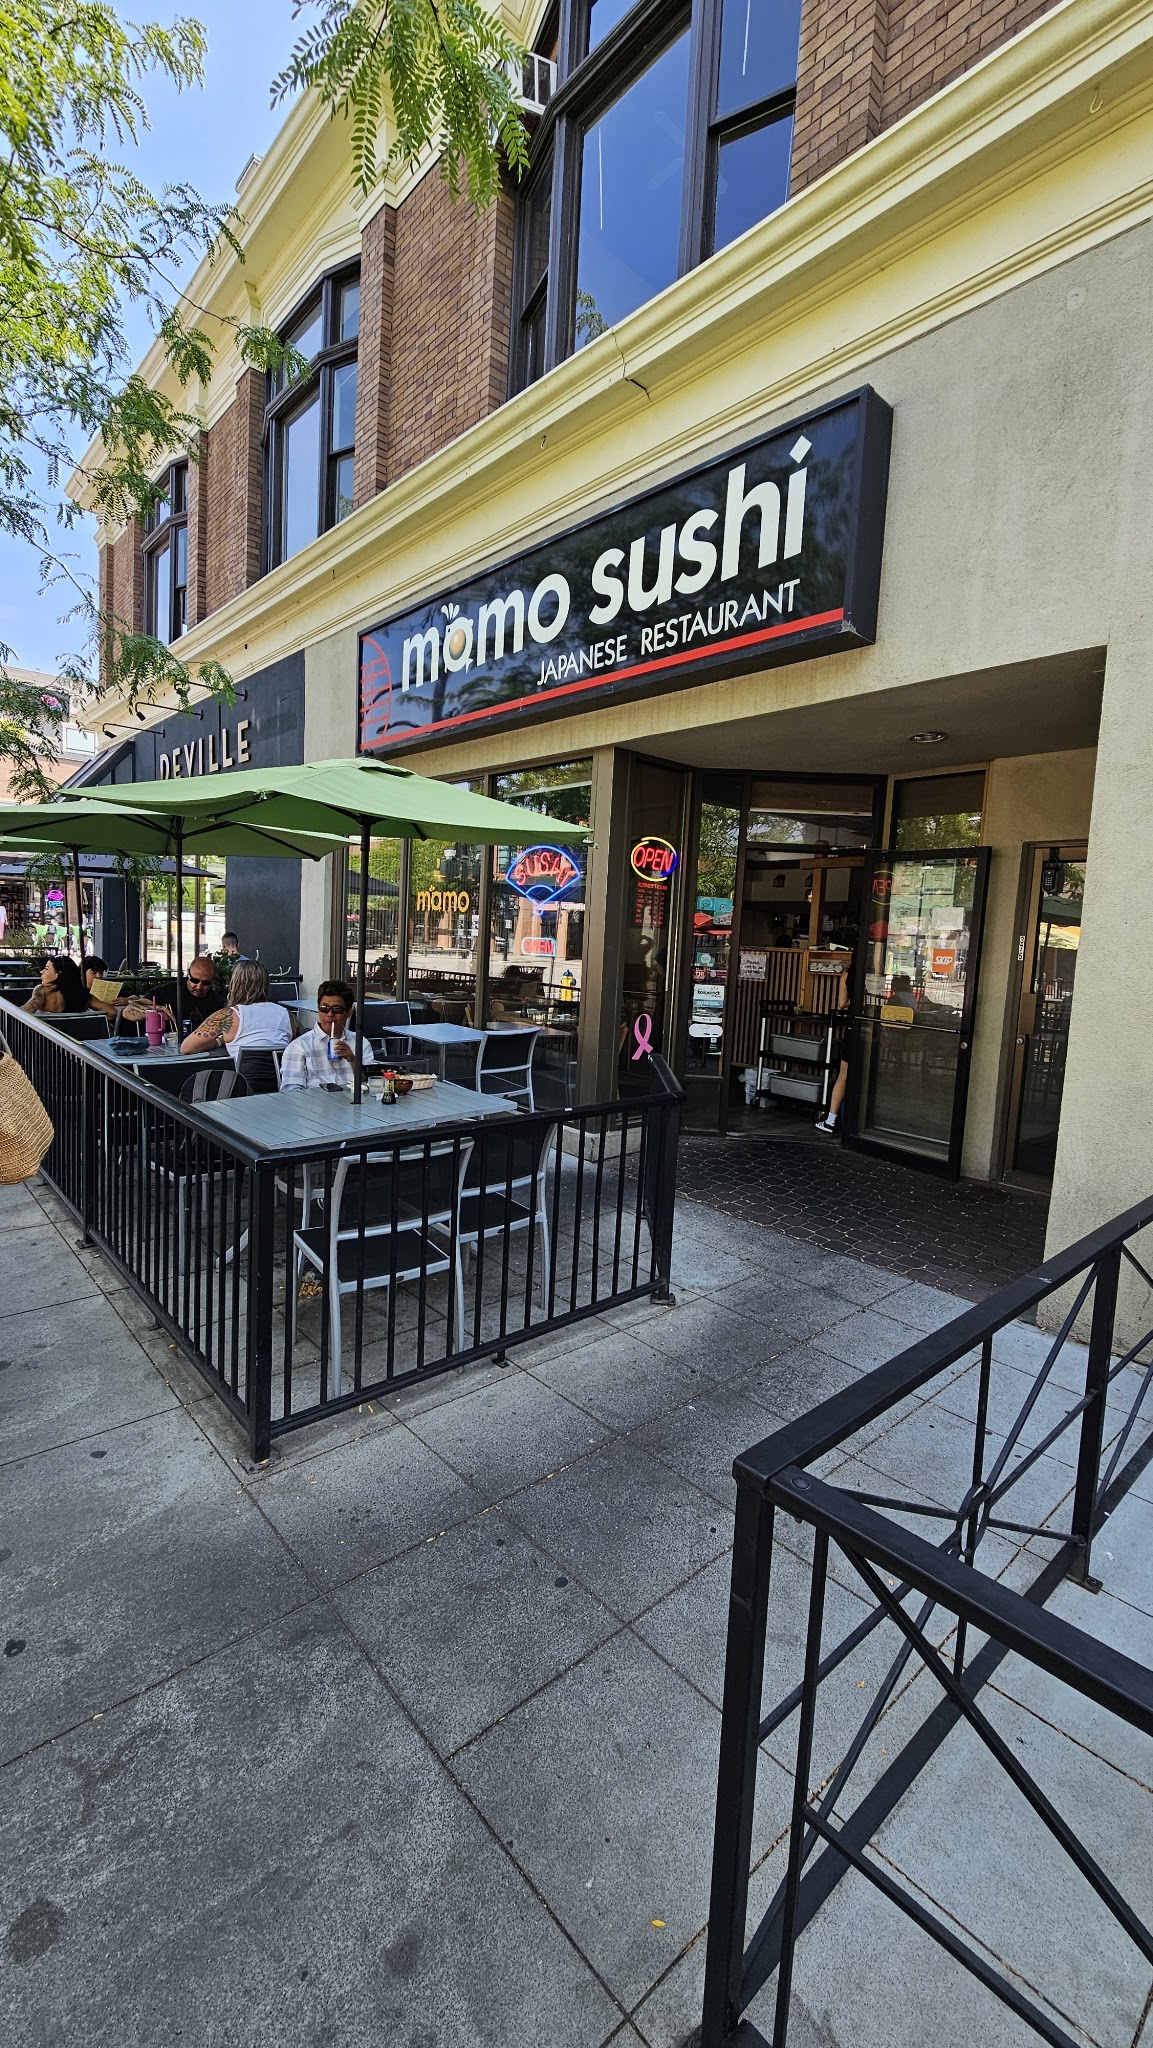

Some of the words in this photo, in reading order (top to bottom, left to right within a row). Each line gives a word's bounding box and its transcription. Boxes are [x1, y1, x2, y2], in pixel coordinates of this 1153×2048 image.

[402, 573, 570, 692] momo
[588, 434, 812, 625] sushi
[536, 634, 628, 686] JAPANESE
[641, 578, 800, 656] RESTAURANT
[160, 719, 250, 780] DEVILLE
[634, 846, 674, 872] OPEN
[524, 940, 553, 953] OPEN
[933, 954, 954, 966] SKIP
